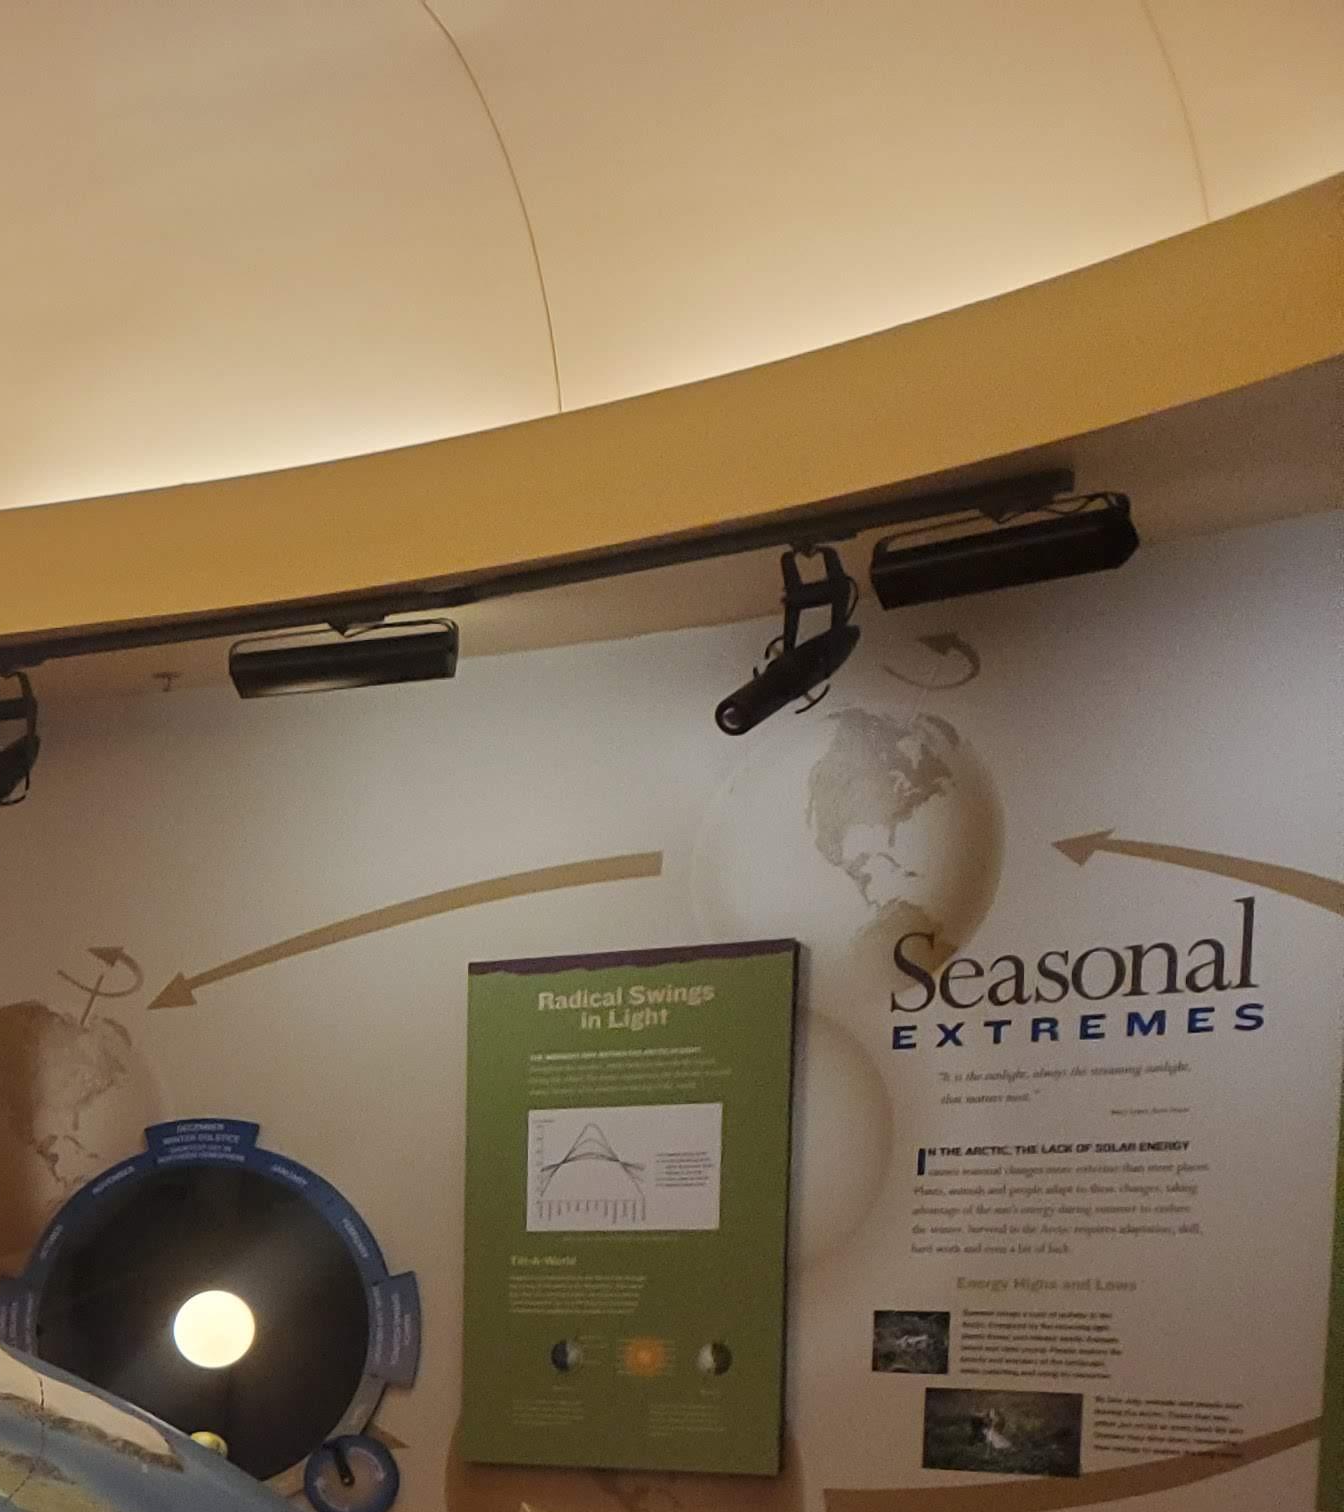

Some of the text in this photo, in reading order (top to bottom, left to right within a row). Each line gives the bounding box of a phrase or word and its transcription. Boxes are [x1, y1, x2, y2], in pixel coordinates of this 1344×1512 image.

[890, 896, 1259, 1013] Seasonal
[538, 984, 715, 1011] Radical Swings
[581, 1008, 669, 1031] in Light
[892, 1003, 1265, 1050] EXTREMES
[940, 1148, 962, 1156] THE
[1015, 1145, 1037, 1154] THE
[1041, 1144, 1073, 1154] LACK
[1076, 1143, 1090, 1153] OF
[1095, 1142, 1136, 1153] SOLAR
[1139, 1141, 1190, 1151] ENERGY
[957, 1277, 1008, 1292] Energy
[1063, 1278, 1090, 1290] and
[1096, 1279, 1137, 1291] Lows
